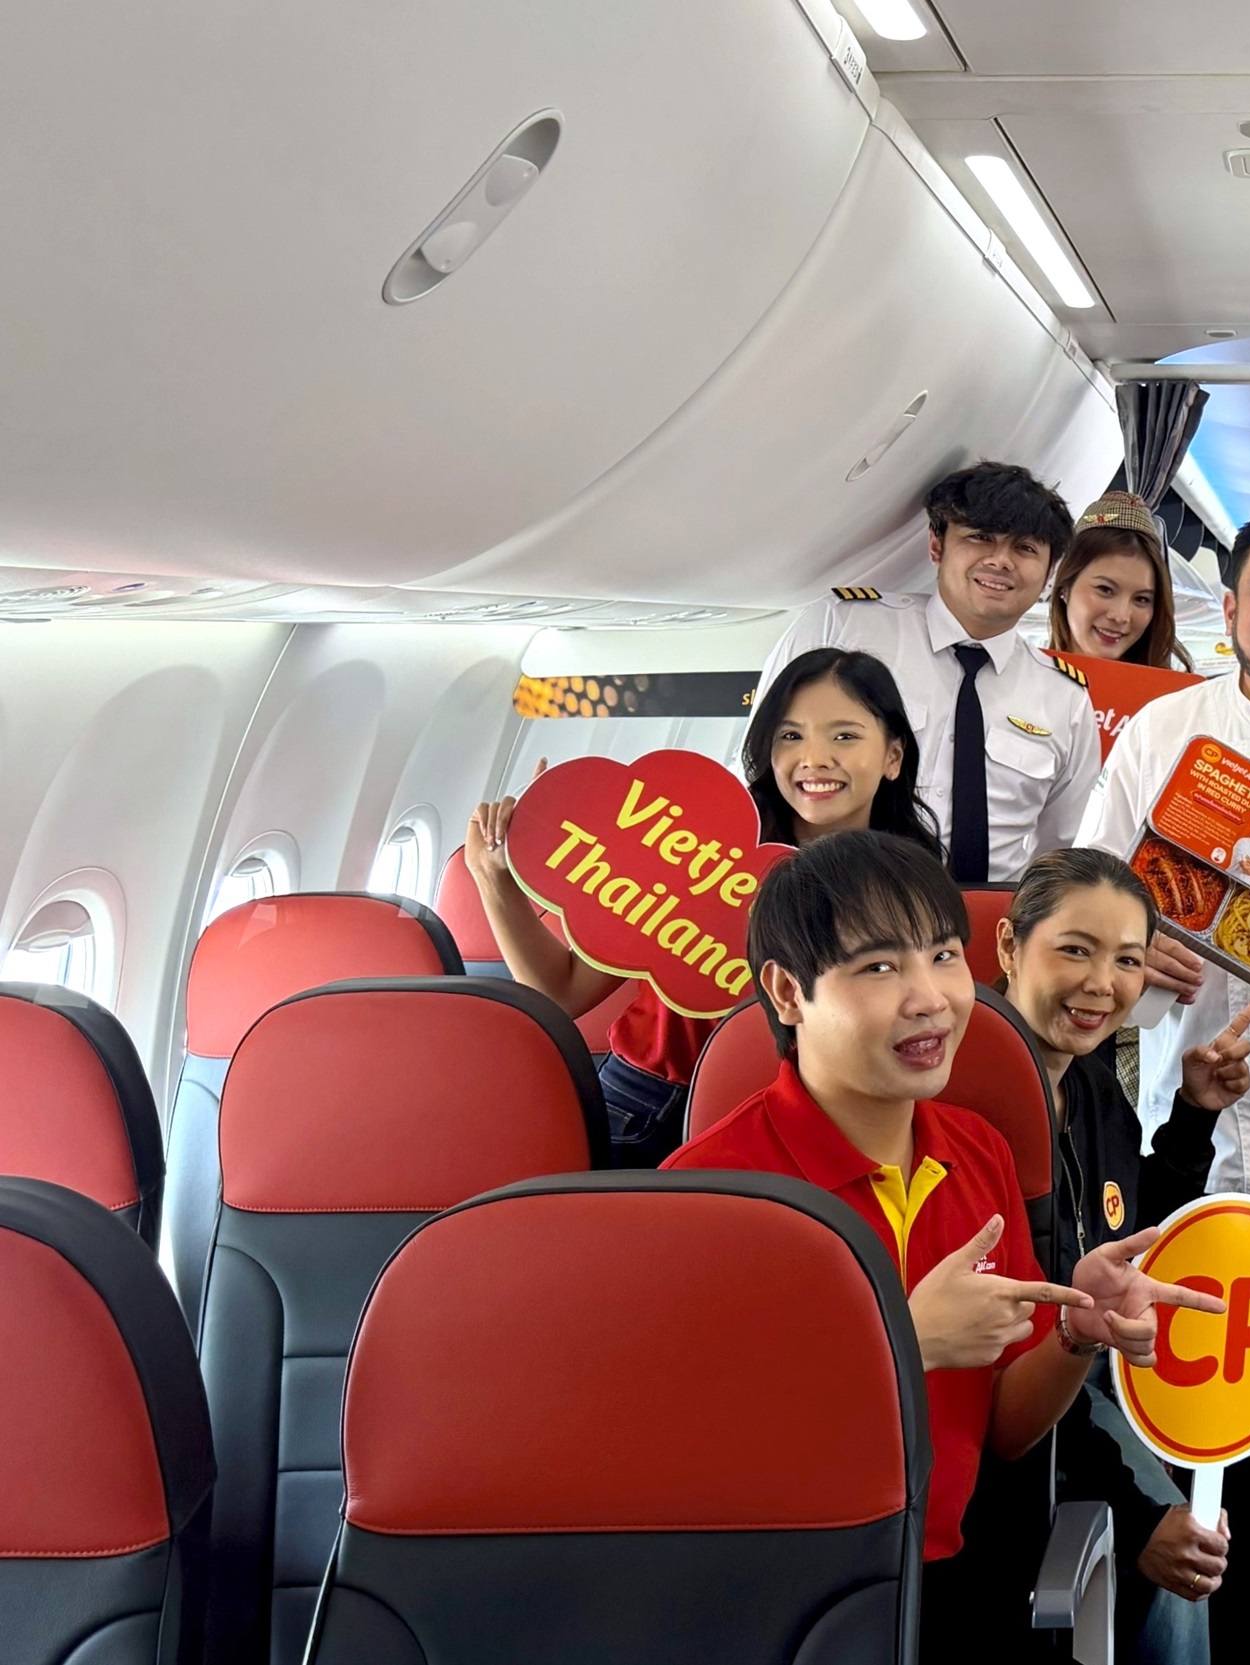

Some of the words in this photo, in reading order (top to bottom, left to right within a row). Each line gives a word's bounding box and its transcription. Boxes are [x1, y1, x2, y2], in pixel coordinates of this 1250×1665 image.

[1204, 747, 1219, 759] CP
[1190, 769, 1209, 785] WITH
[1208, 780, 1242, 802] ROASTED
[1197, 782, 1206, 792] IN
[1206, 786, 1221, 799] RED
[1220, 796, 1247, 814] CURRY
[616, 778, 758, 908] Vietje
[1106, 1194, 1120, 1218] CP
